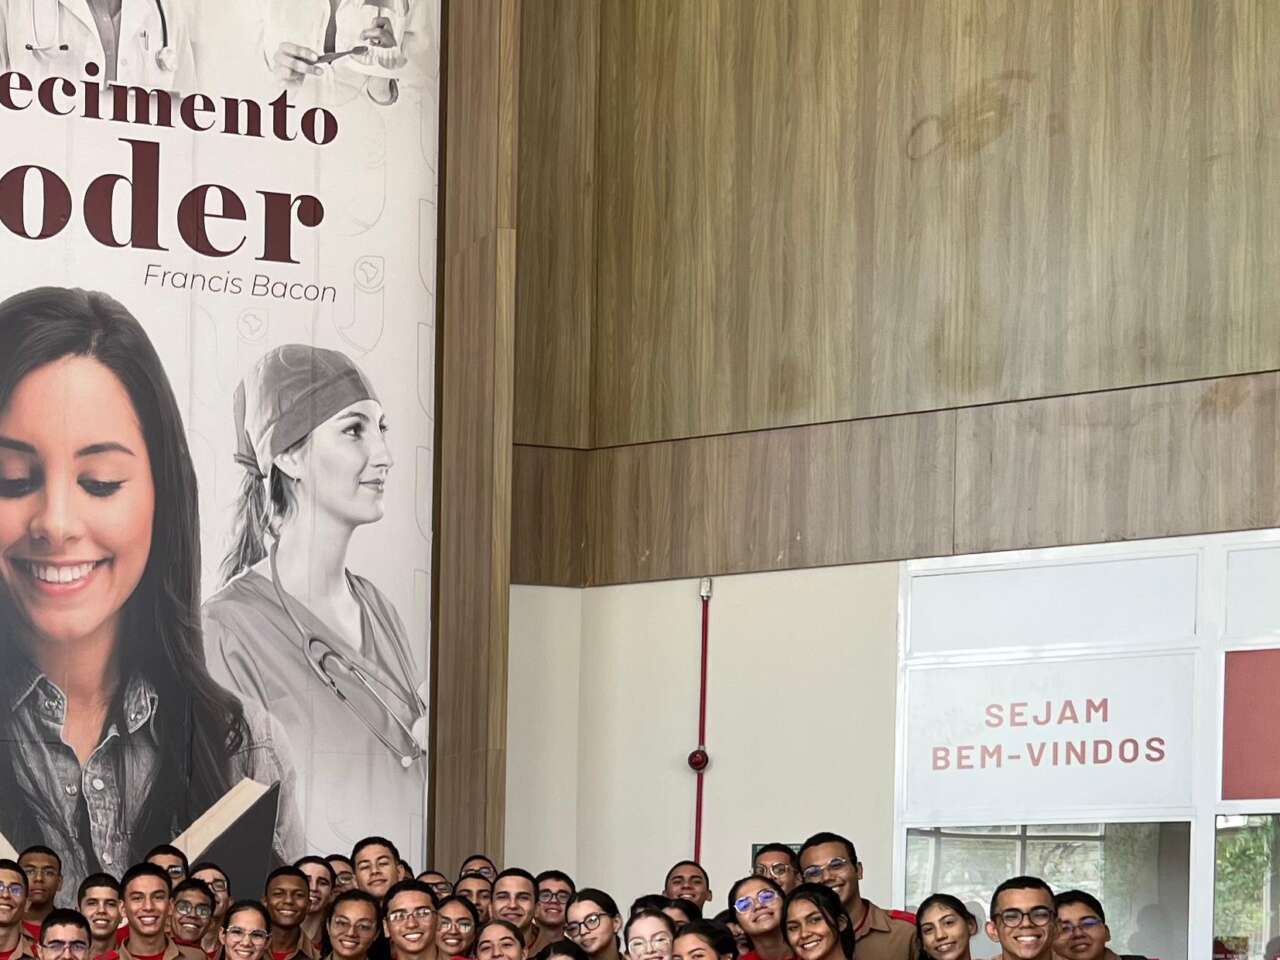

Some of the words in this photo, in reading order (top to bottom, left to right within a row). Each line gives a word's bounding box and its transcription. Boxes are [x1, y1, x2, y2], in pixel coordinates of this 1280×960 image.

[143, 263, 243, 296] Francis
[251, 274, 338, 304] Bacon
[984, 697, 1109, 728] SEJAM
[932, 737, 1166, 771] BEM-VINDOS
